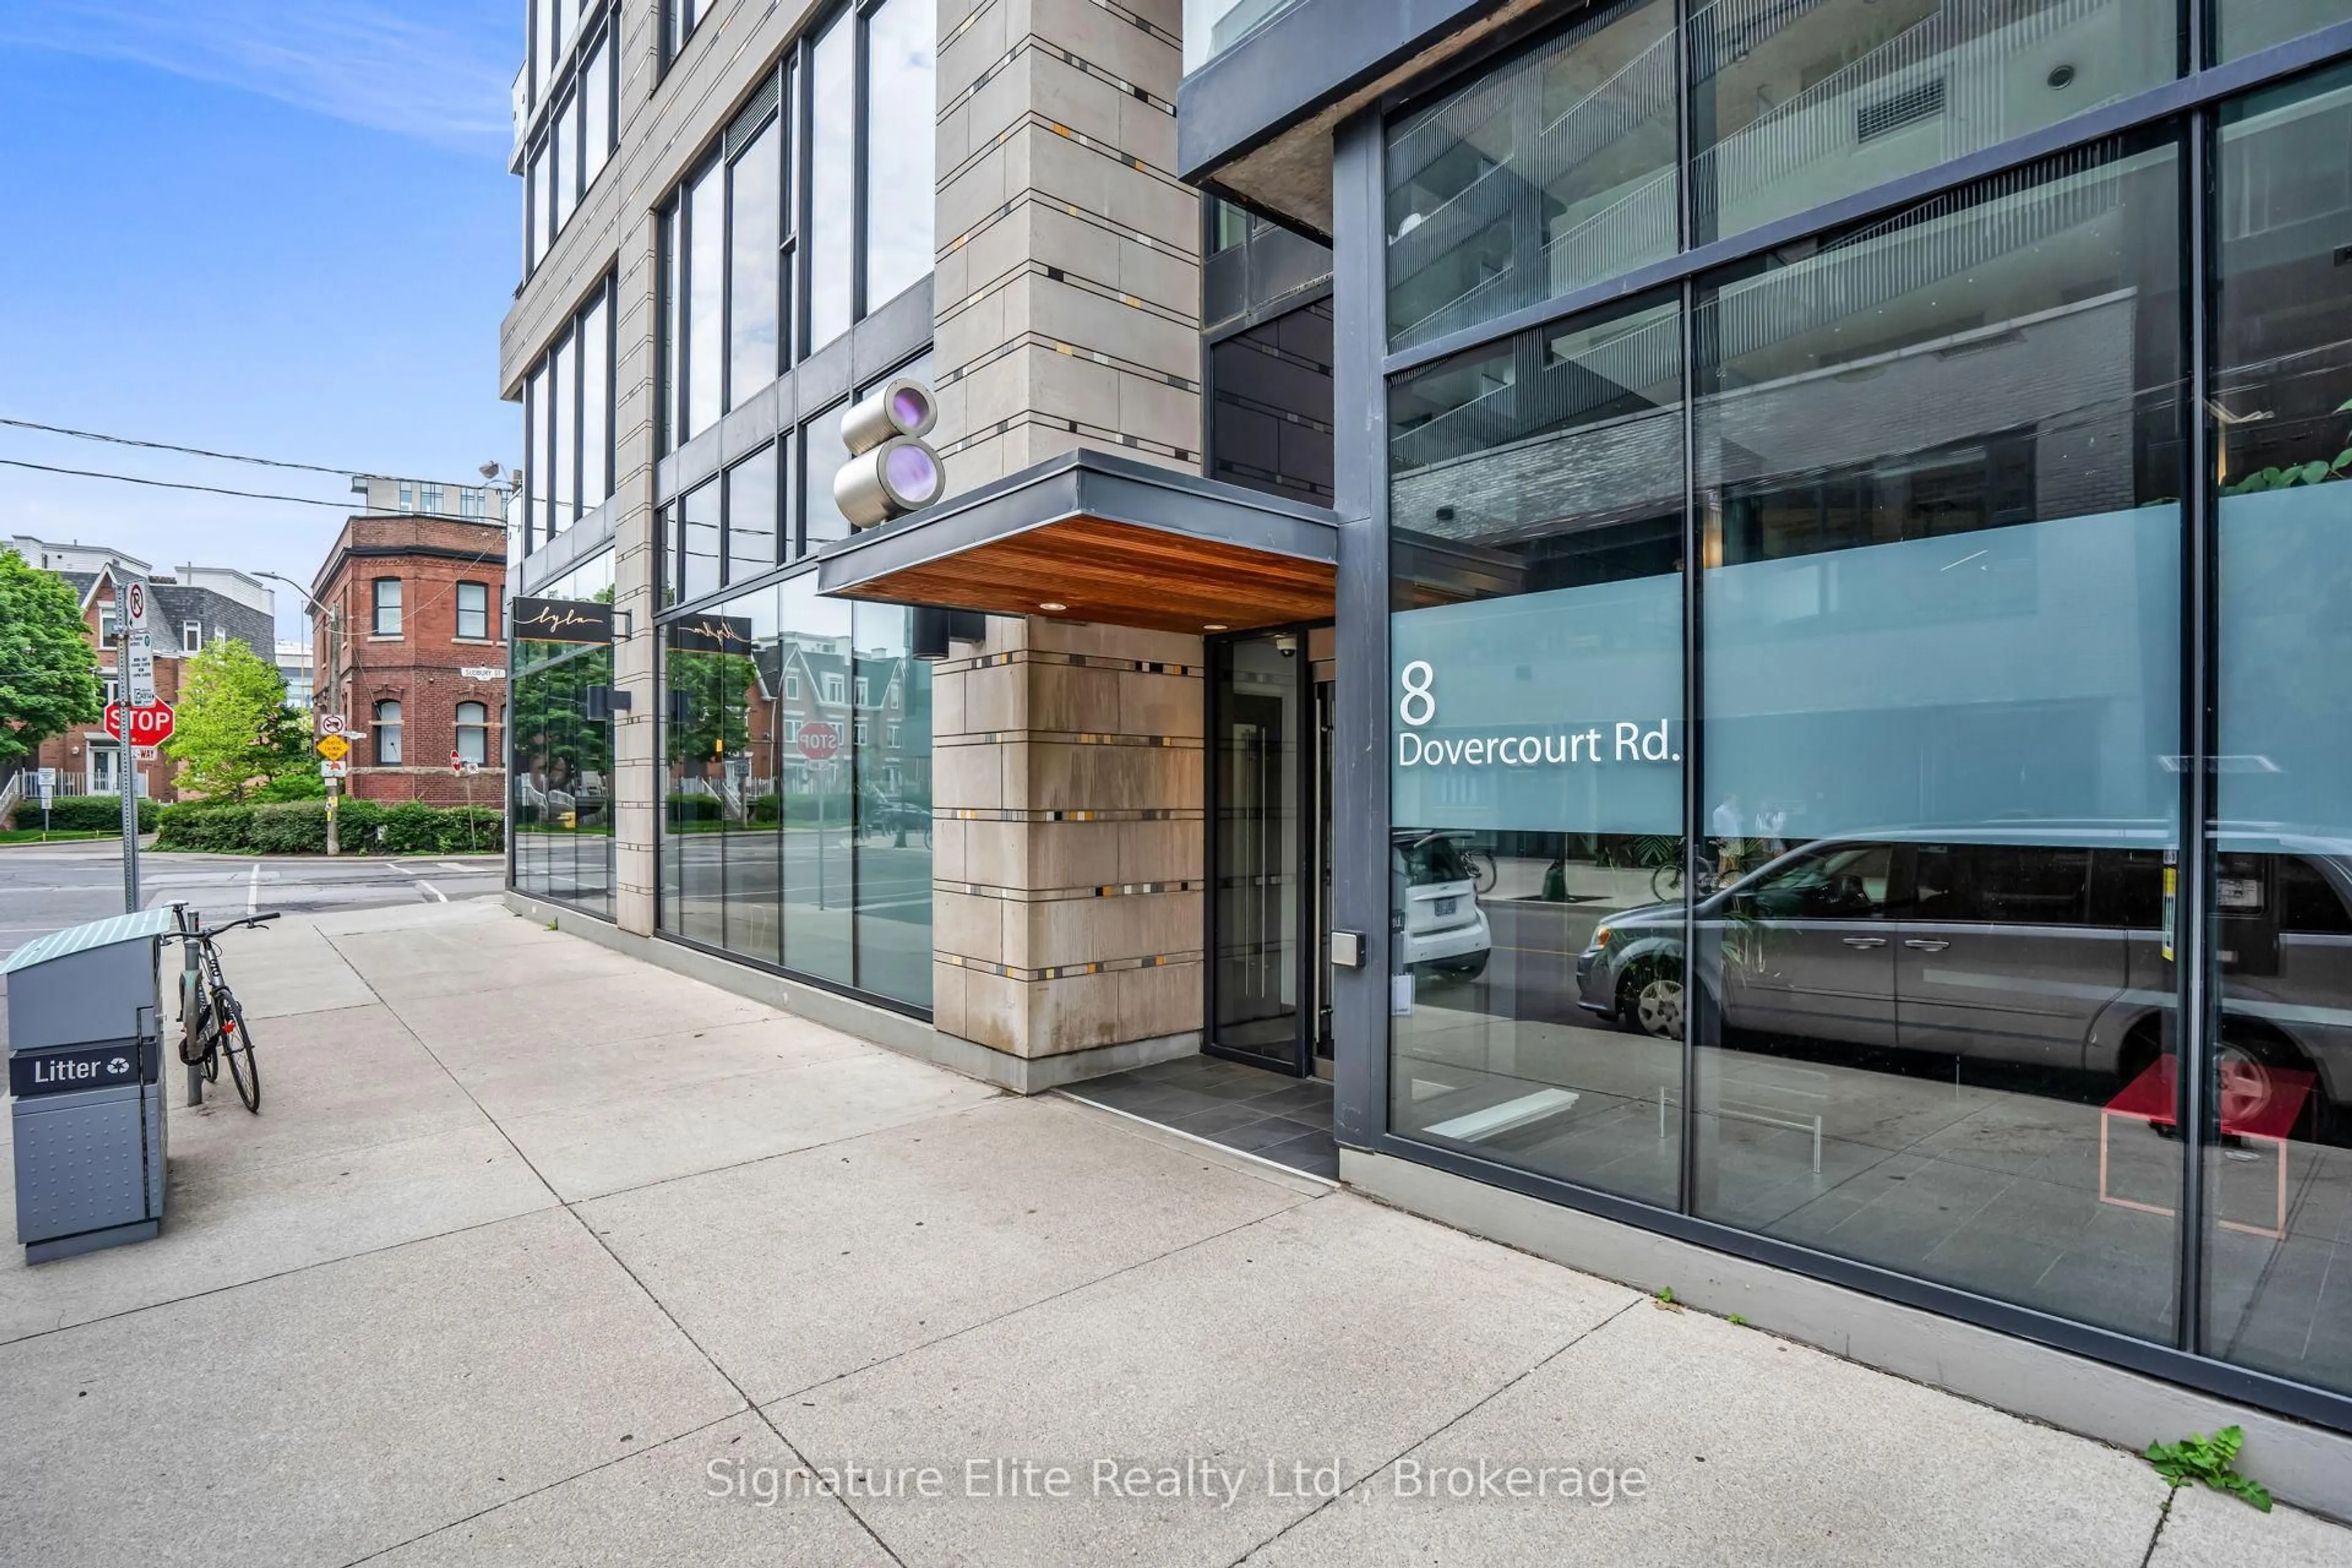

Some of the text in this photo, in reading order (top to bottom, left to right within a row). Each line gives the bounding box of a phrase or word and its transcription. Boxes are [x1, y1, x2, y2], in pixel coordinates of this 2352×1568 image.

[1400, 660, 1435, 726] 8
[110, 709, 170, 731] STOP
[1399, 718, 1681, 766] Dovercourt Rd.
[35, 1060, 101, 1083] Litter
